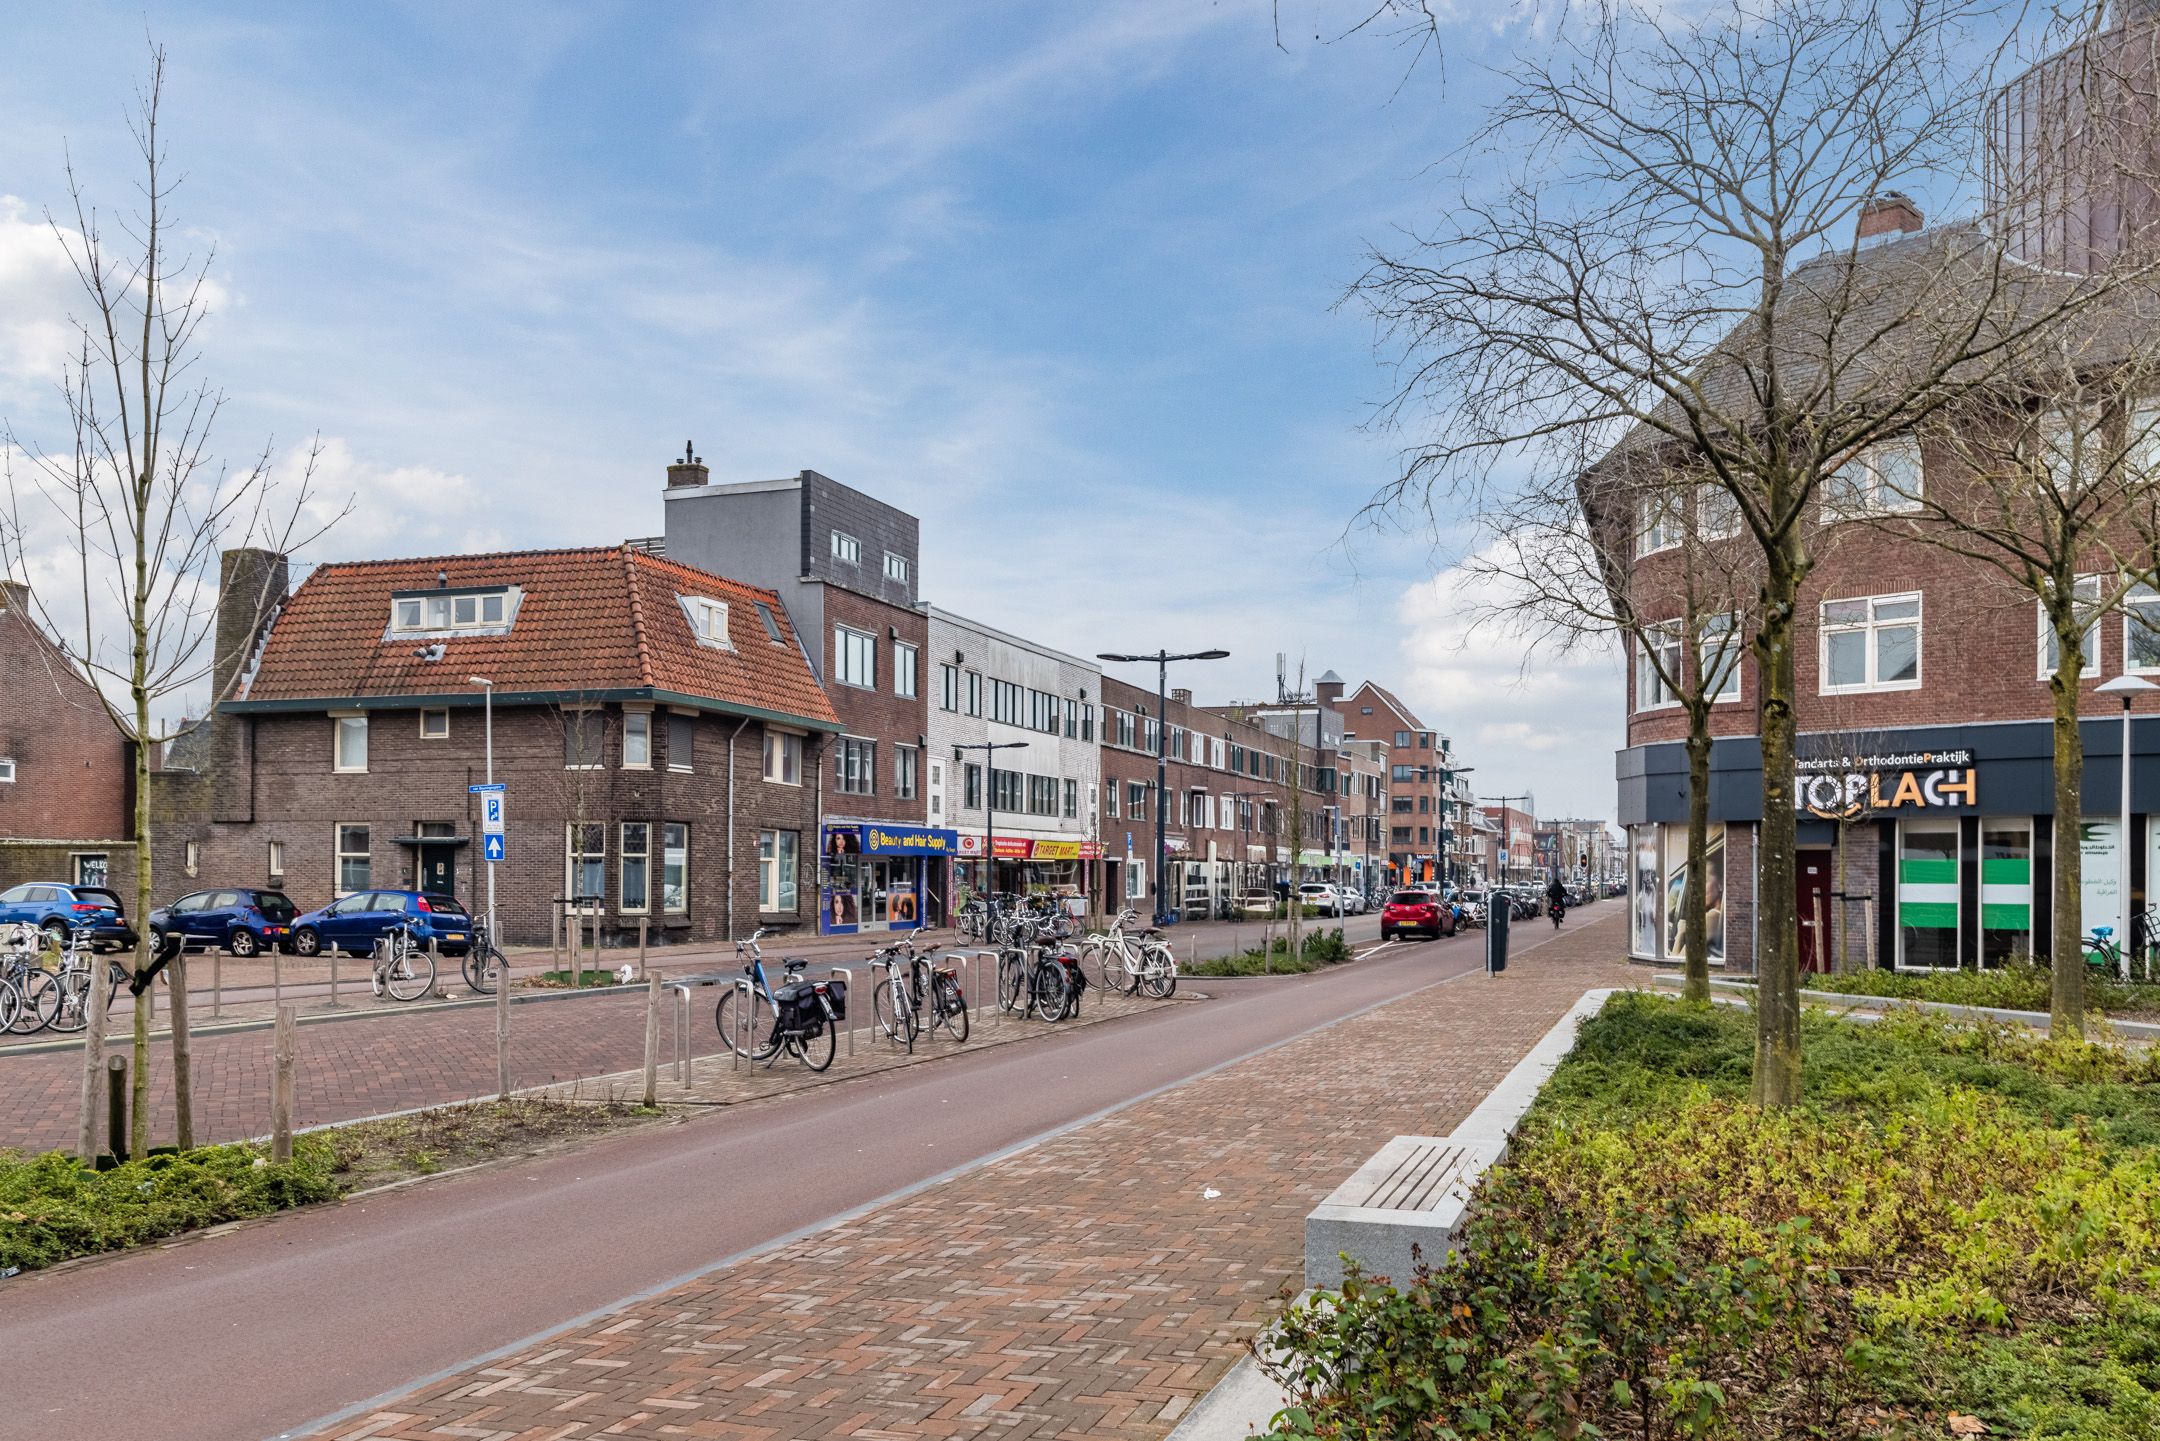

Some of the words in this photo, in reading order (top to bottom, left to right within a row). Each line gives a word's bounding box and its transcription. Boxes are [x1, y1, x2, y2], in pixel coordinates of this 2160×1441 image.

[1842, 756, 1851, 767] &
[1855, 750, 1970, 767] OrthodontiePraktijk
[490, 801, 497, 813] P
[880, 832, 901, 848] Beauty
[903, 834, 914, 847] and
[915, 834, 927, 847] Hair
[928, 834, 946, 850] Supply
[1039, 845, 1060, 856] TARGET
[1059, 846, 1075, 856] MART
